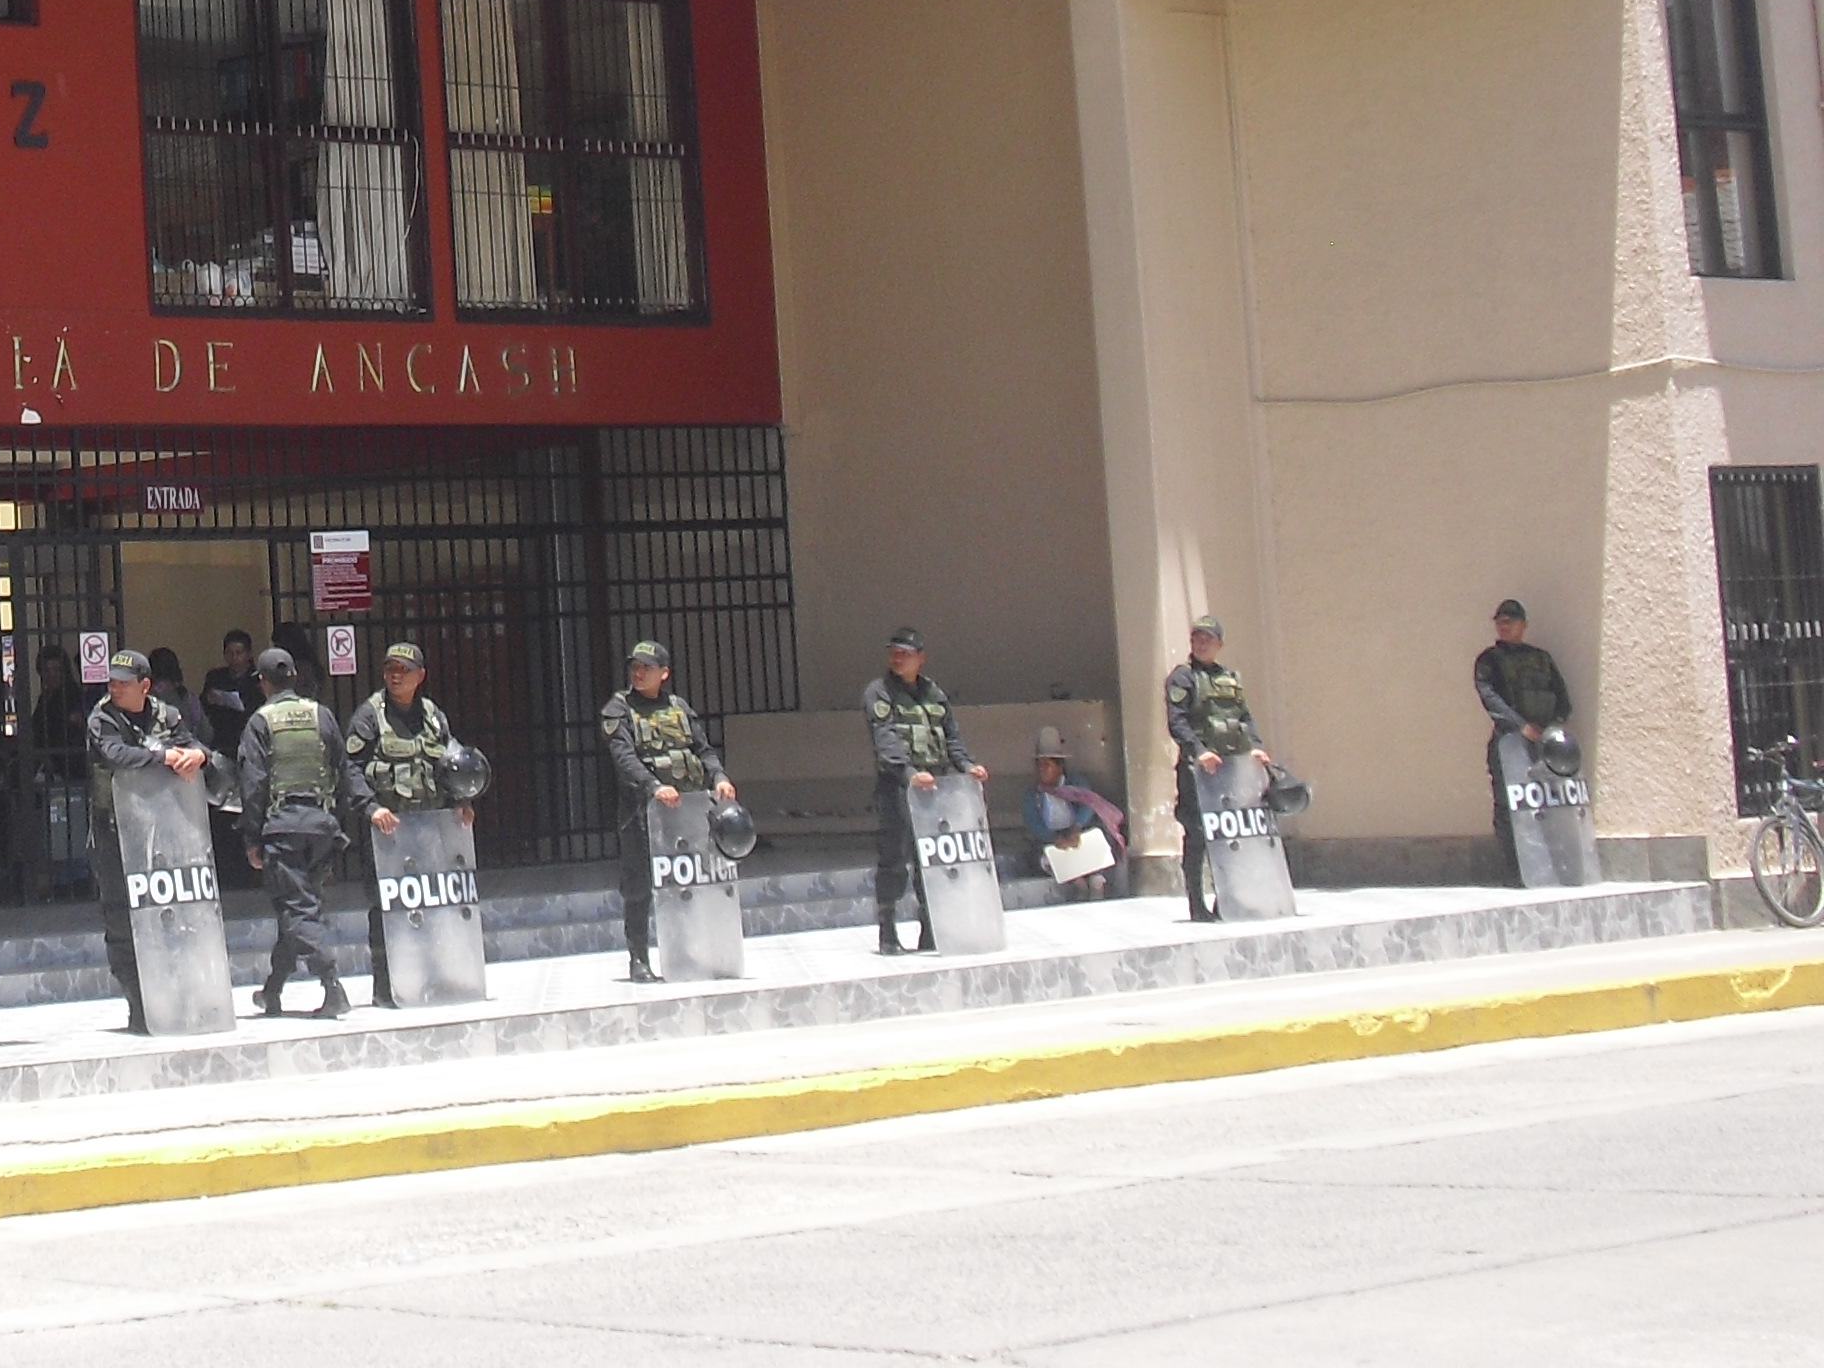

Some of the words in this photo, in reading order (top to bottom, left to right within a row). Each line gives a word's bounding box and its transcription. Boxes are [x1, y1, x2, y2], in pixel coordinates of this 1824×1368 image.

[153, 338, 237, 394] DE
[309, 341, 579, 395] ANCASH
[146, 486, 201, 510] ENTRADA
[1507, 778, 1591, 811] POLICIA
[379, 872, 479, 911] POLICIA
